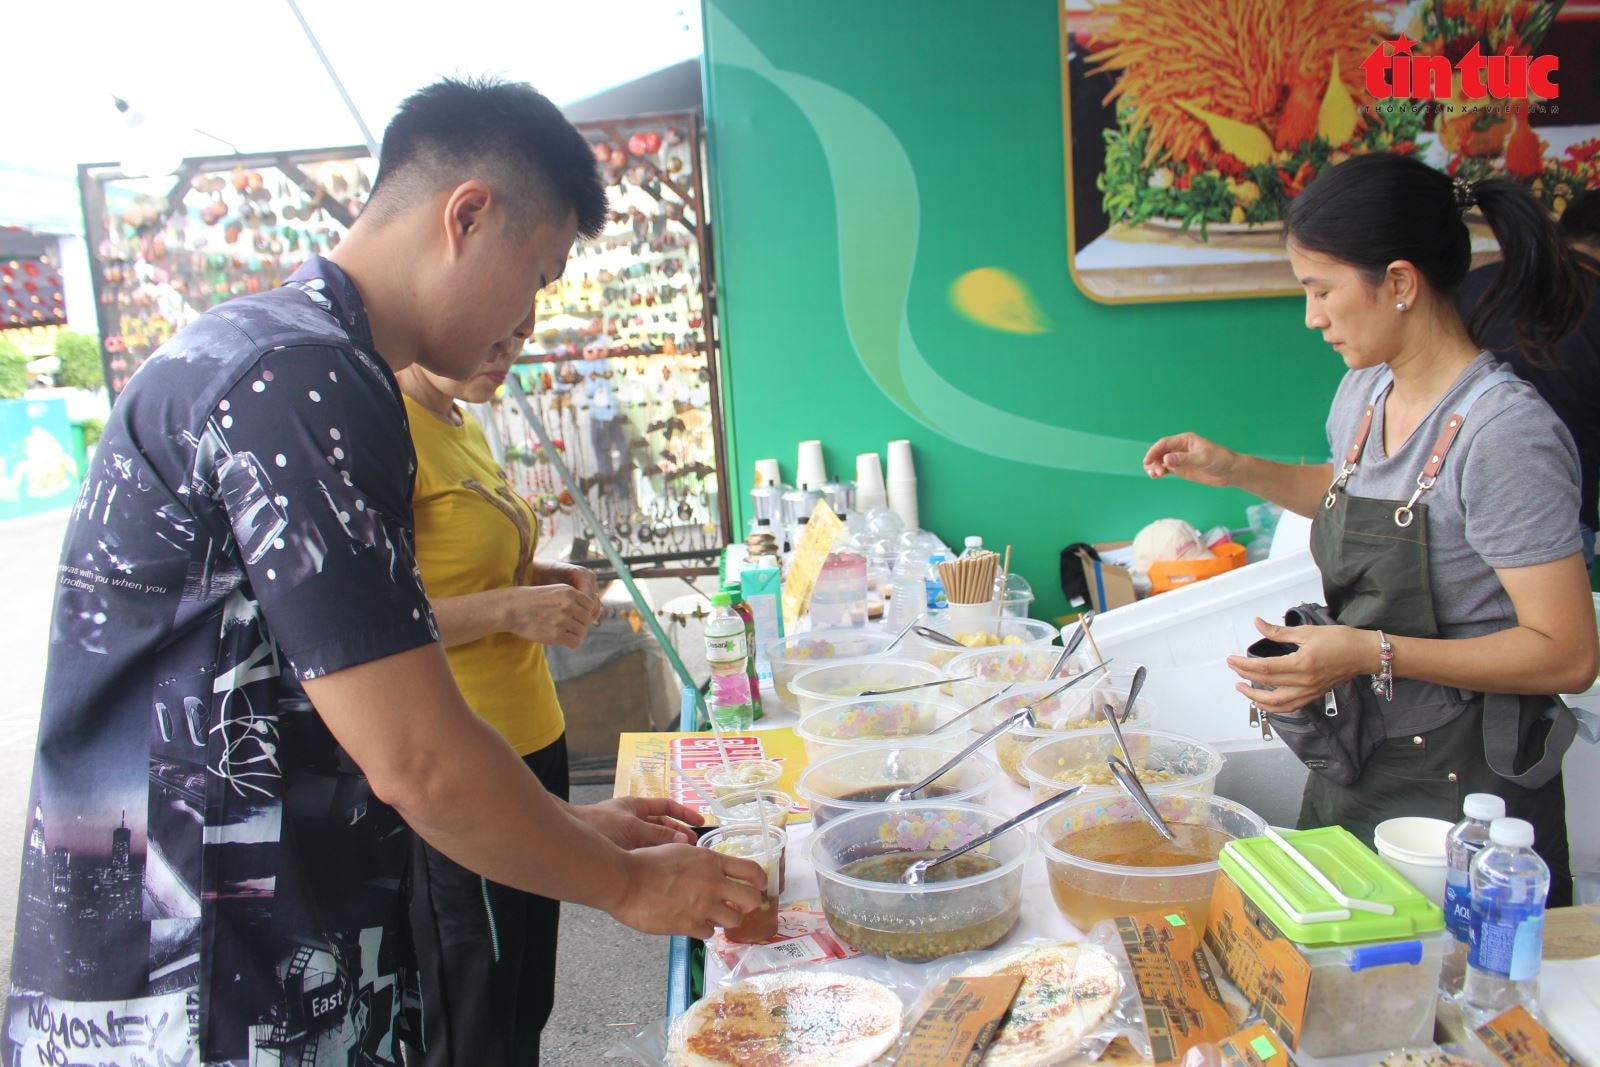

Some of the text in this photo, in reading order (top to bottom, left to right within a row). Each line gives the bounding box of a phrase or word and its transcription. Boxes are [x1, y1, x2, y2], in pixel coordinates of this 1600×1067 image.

[79, 569, 94, 579] with
[94, 574, 109, 584] you
[111, 578, 142, 590] when
[144, 585, 168, 594] you
[312, 989, 343, 1018] East
[28, 1003, 50, 1033] NO
[49, 1009, 169, 1050] MONEY
